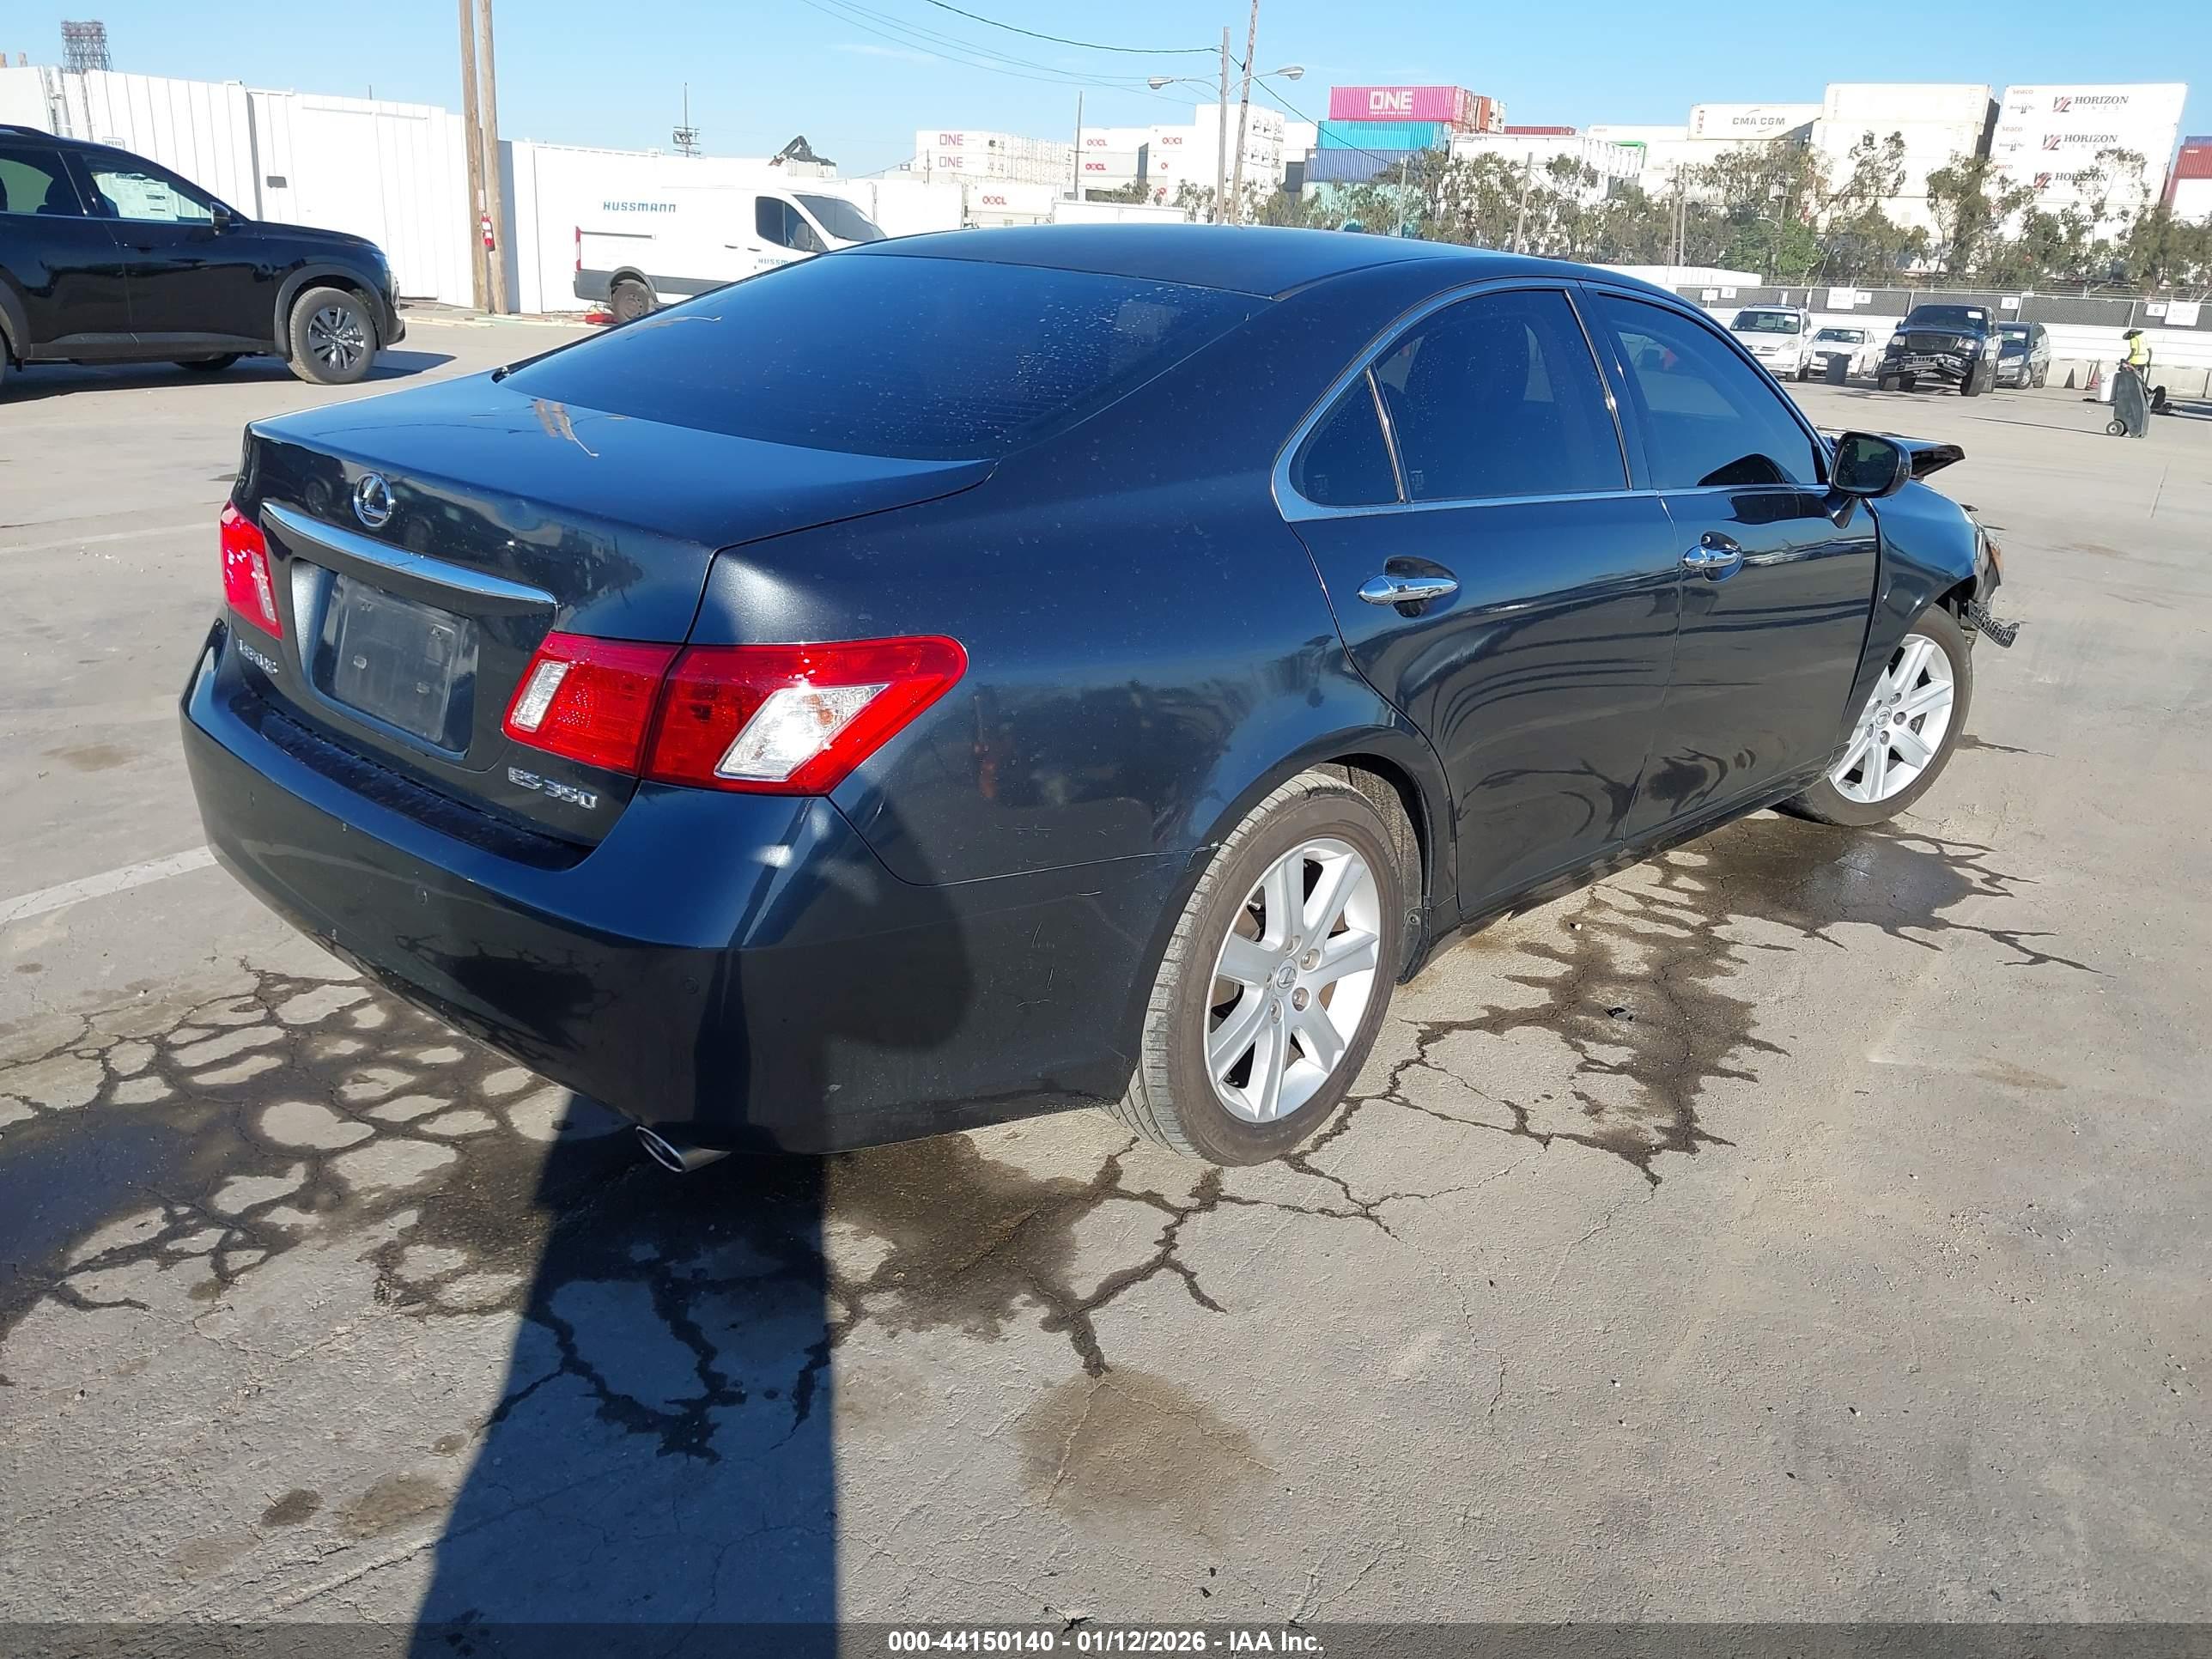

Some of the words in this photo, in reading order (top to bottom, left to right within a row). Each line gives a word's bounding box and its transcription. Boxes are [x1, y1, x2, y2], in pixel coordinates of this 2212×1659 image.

[1369, 91, 1413, 110] ONE
[2074, 95, 2130, 104] HORIZON
[1732, 117, 1757, 125] CMA
[939, 134, 964, 146] ONE
[2063, 134, 2118, 143] HORIZON
[939, 156, 963, 168] ONE
[982, 196, 1007, 205] OOCL
[603, 201, 677, 213] HUSSMANN
[507, 767, 543, 790] ES
[544, 779, 599, 811] 350
